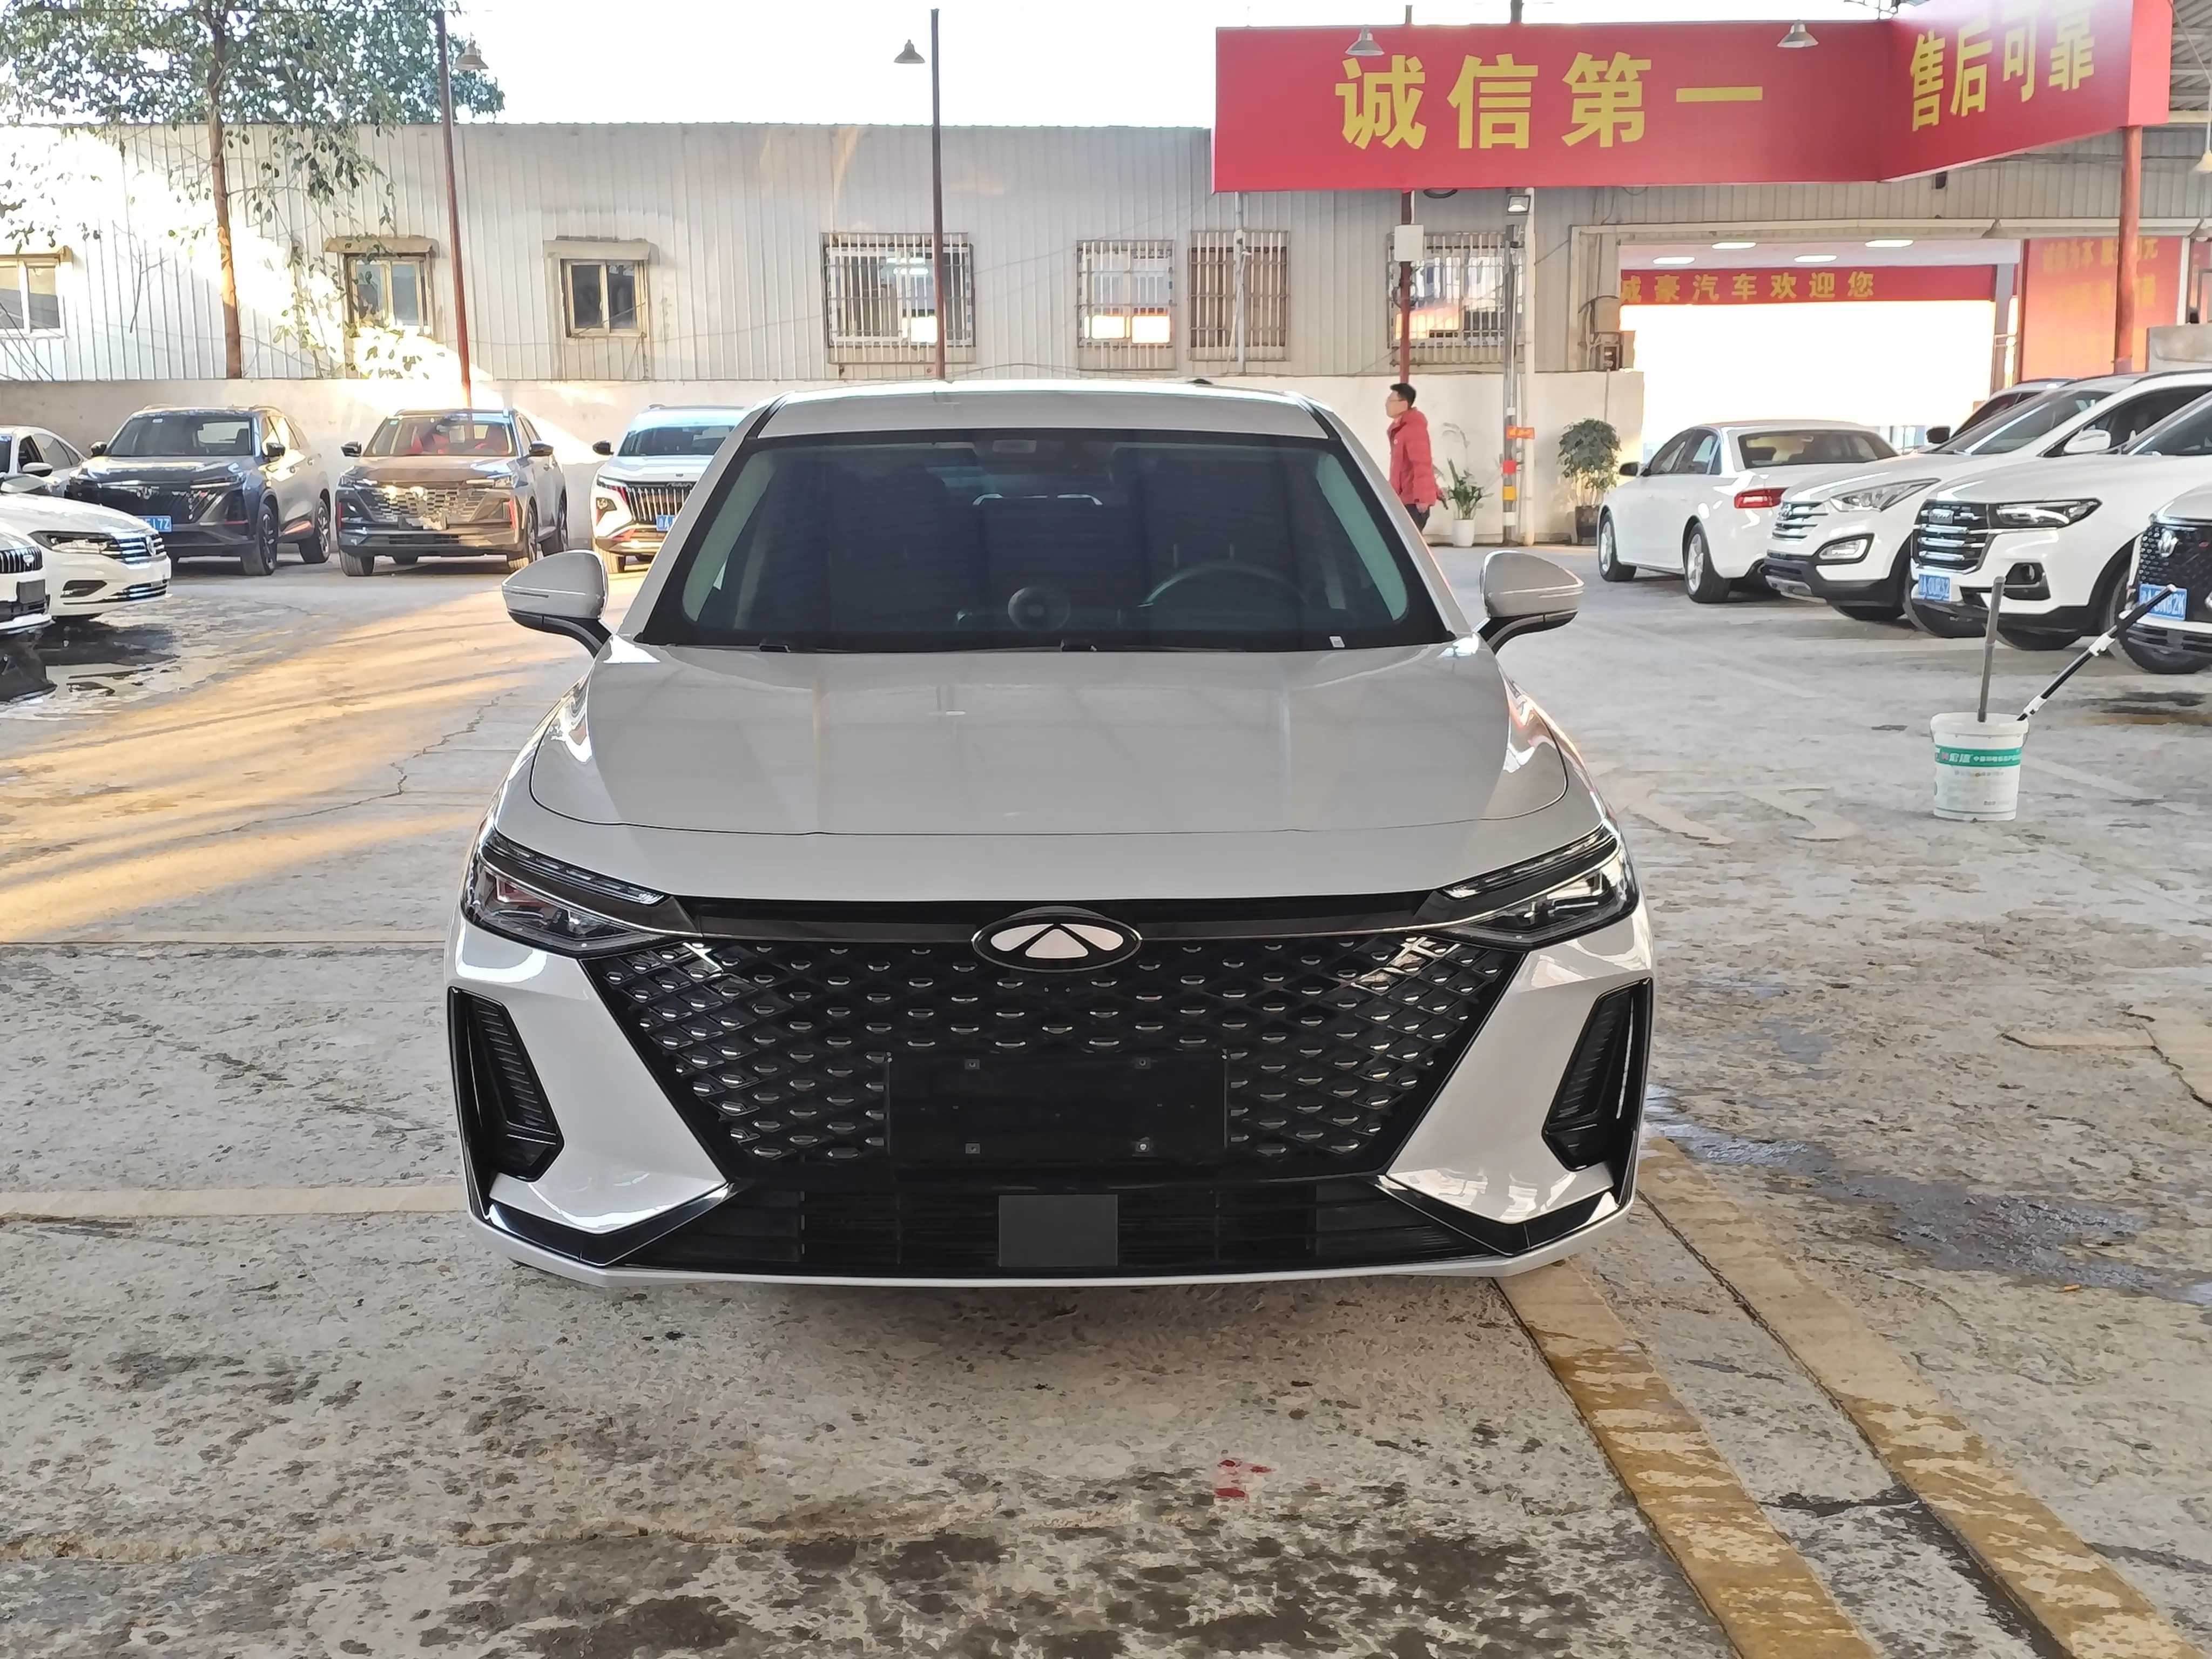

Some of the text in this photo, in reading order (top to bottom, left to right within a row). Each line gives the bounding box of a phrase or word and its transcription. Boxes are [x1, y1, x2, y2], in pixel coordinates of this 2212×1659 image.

[1335, 51, 1763, 149] 诚信第一
[1910, 0, 2095, 132] 售后可靠
